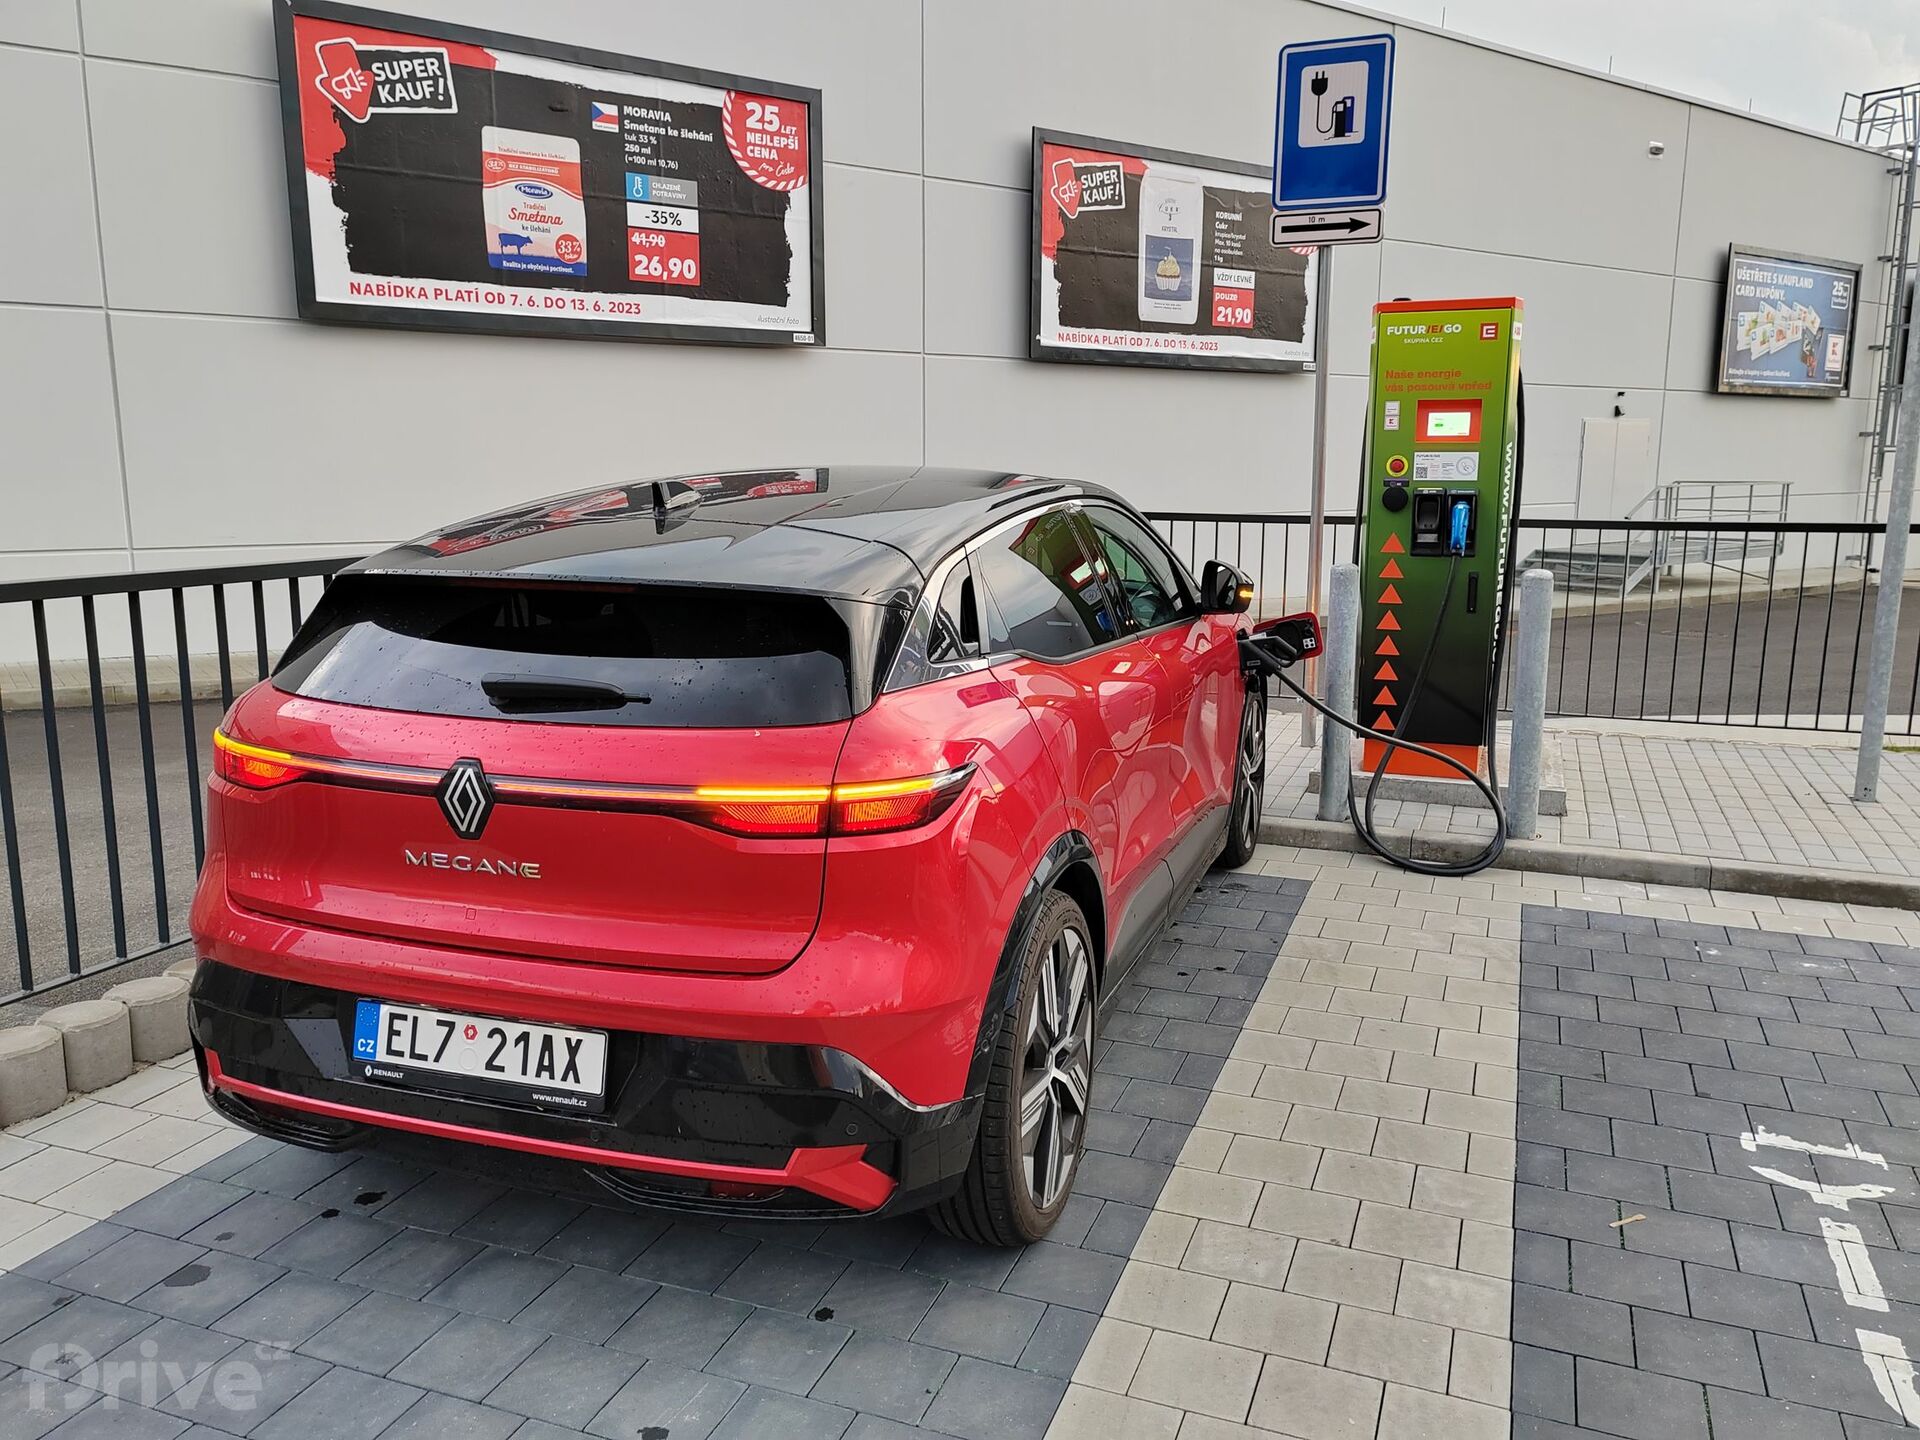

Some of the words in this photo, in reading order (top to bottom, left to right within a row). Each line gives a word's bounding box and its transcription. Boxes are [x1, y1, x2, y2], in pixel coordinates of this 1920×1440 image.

[371, 57, 443, 82] SUPER
[377, 78, 444, 103] KAUF!
[623, 106, 672, 122] MORAVIA
[745, 102, 780, 132] 25
[781, 125, 797, 135] LET
[624, 120, 666, 135] Smetana
[668, 127, 678, 136] ke
[681, 128, 713, 142] šlehání
[624, 133, 638, 141] tuk
[638, 135, 648, 143] 33
[649, 136, 657, 145] %
[625, 144, 640, 153] 250
[747, 132, 799, 150] NEJLEPŠÍ
[625, 154, 646, 165] (=100
[648, 158, 657, 166] ml
[747, 146, 778, 160] CENA
[1081, 170, 1119, 188] SUPER
[652, 190, 687, 200] POTRAVINY
[1083, 185, 1120, 204] KAUF!
[508, 207, 564, 225] Smetana
[645, 210, 682, 226] -35%
[1215, 211, 1242, 221] KORUNNÍ
[1215, 222, 1228, 230] Cukr
[631, 232, 666, 248] 41,90
[634, 254, 696, 280] 26,90
[1216, 273, 1232, 281] VŽDY
[1234, 275, 1252, 284] LEVNÉ
[1737, 267, 1772, 283] UŠETŘETE
[1773, 273, 1777, 284] S
[1778, 276, 1813, 289] KAUFLAND
[1215, 292, 1238, 301] pouze
[1736, 285, 1755, 297] CARD
[1833, 281, 1844, 296] 25
[350, 281, 429, 300] NABÍDKA
[434, 287, 480, 303] PLATÍ
[485, 292, 506, 305] OD
[510, 294, 523, 307] 7.
[527, 295, 540, 308] 6.
[544, 296, 566, 309] DO
[570, 299, 589, 312] 13.
[593, 300, 605, 312] 6.
[609, 302, 641, 315] 2023
[1217, 306, 1251, 325] 21,90
[1058, 333, 1100, 345] NABÍDKA
[1103, 334, 1127, 346] PLATÍ
[1130, 338, 1142, 346] OD
[1146, 338, 1152, 347] 7.
[1154, 339, 1162, 348] 6.
[1164, 339, 1176, 348] DO
[1179, 340, 1189, 349] 13.
[1191, 341, 1198, 349] 6.
[1200, 342, 1218, 351] 2023
[1385, 370, 1414, 379] Naše
[1418, 370, 1462, 380] energie
[1385, 383, 1403, 392] vás
[1459, 382, 1492, 391] vpřed
[405, 850, 541, 879] MEGANE
[357, 1039, 374, 1053] CZ
[386, 1012, 456, 1063] EL7
[485, 1027, 583, 1084] 21AX
[374, 1068, 404, 1079] RENAULT
[532, 1092, 588, 1107] www.renault.cz
